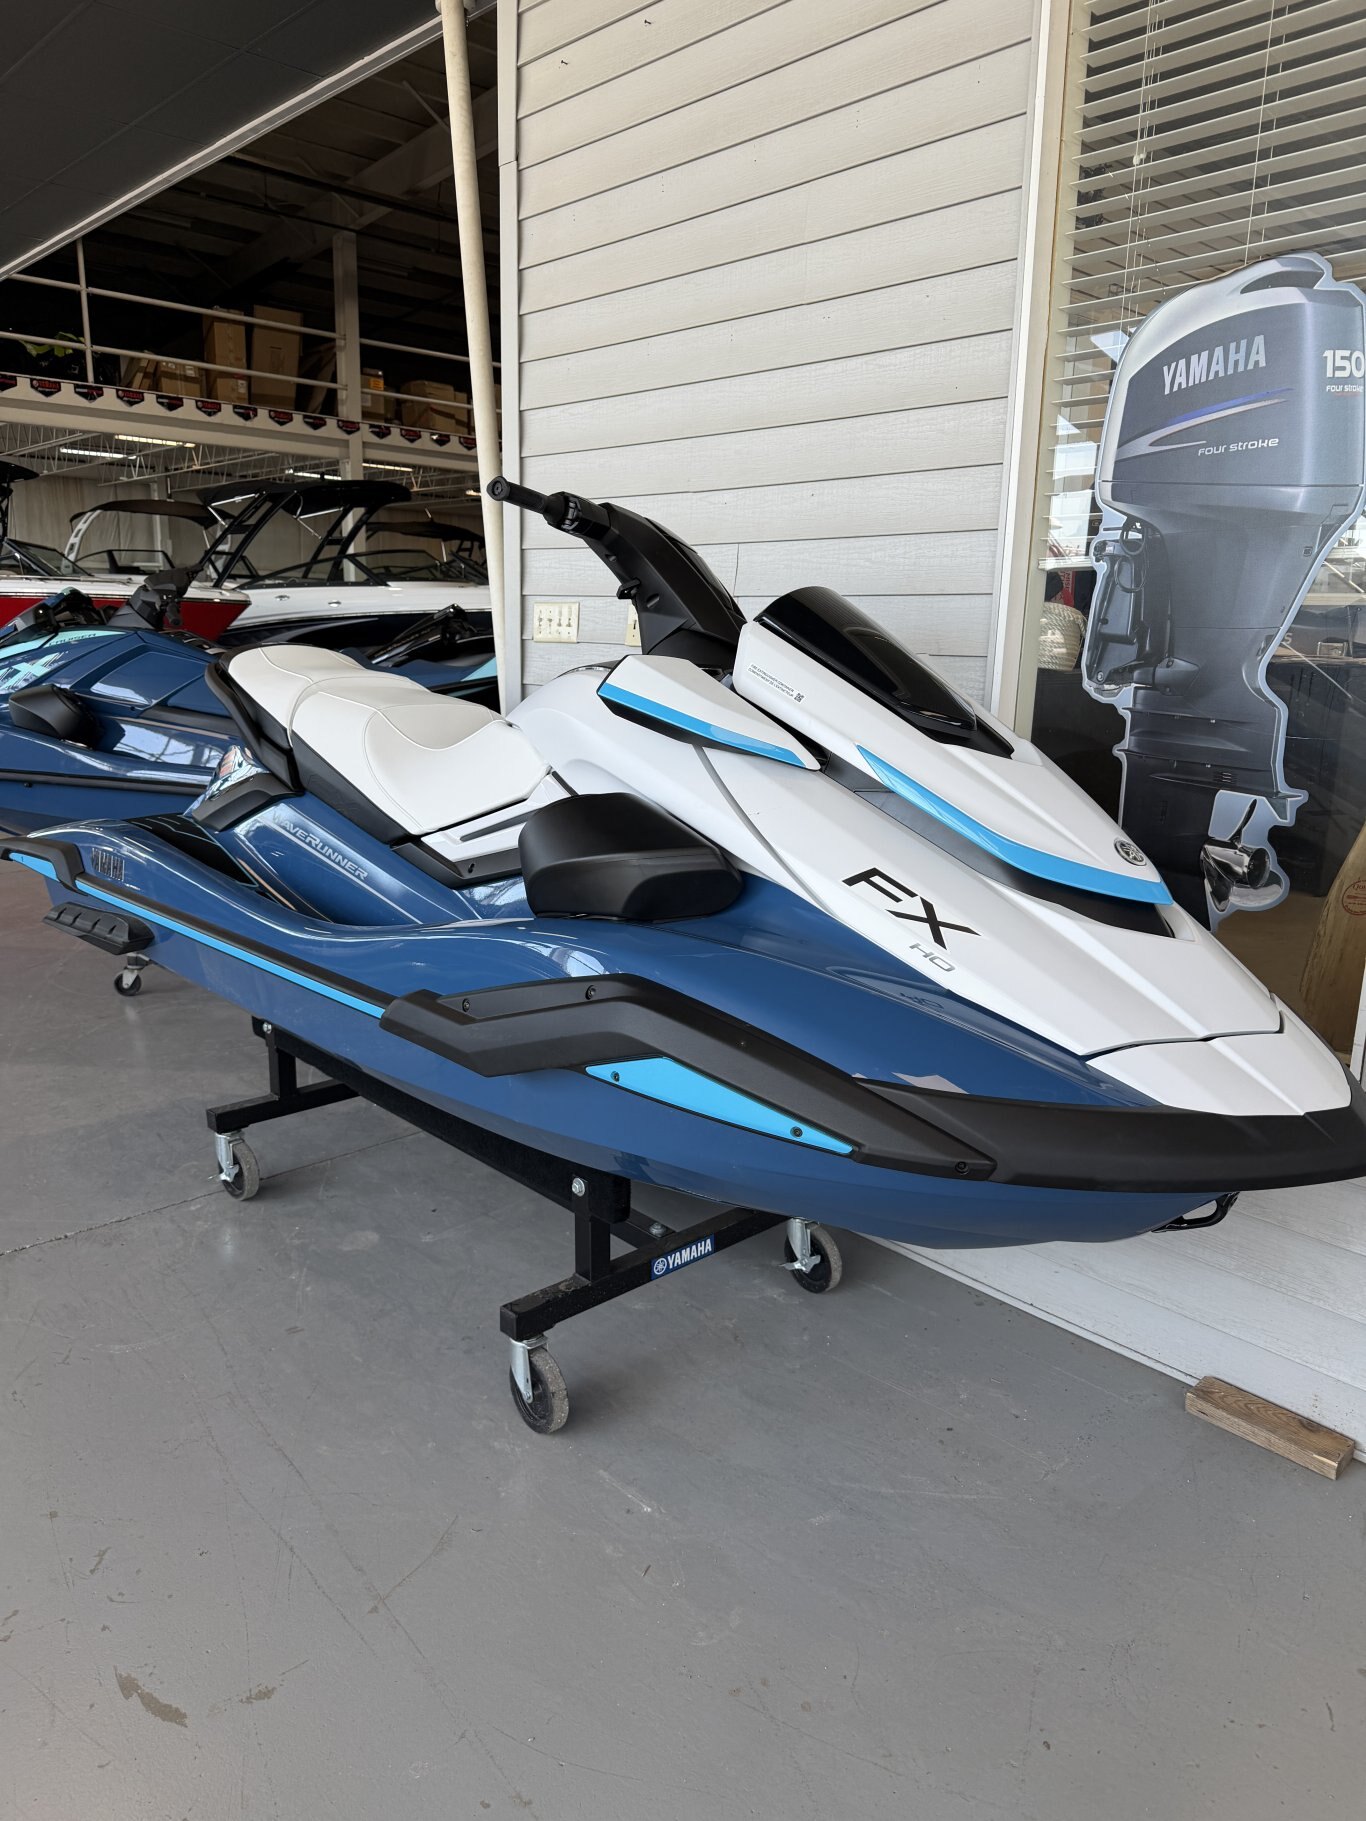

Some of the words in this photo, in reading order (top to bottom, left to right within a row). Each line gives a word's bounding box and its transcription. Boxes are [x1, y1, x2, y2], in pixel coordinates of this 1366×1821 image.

[1163, 334, 1267, 395] YAMAHA
[1323, 349, 1365, 378] 150
[842, 867, 982, 950] FX
[909, 943, 956, 972] HO
[667, 1238, 712, 1269] YAMAHA
